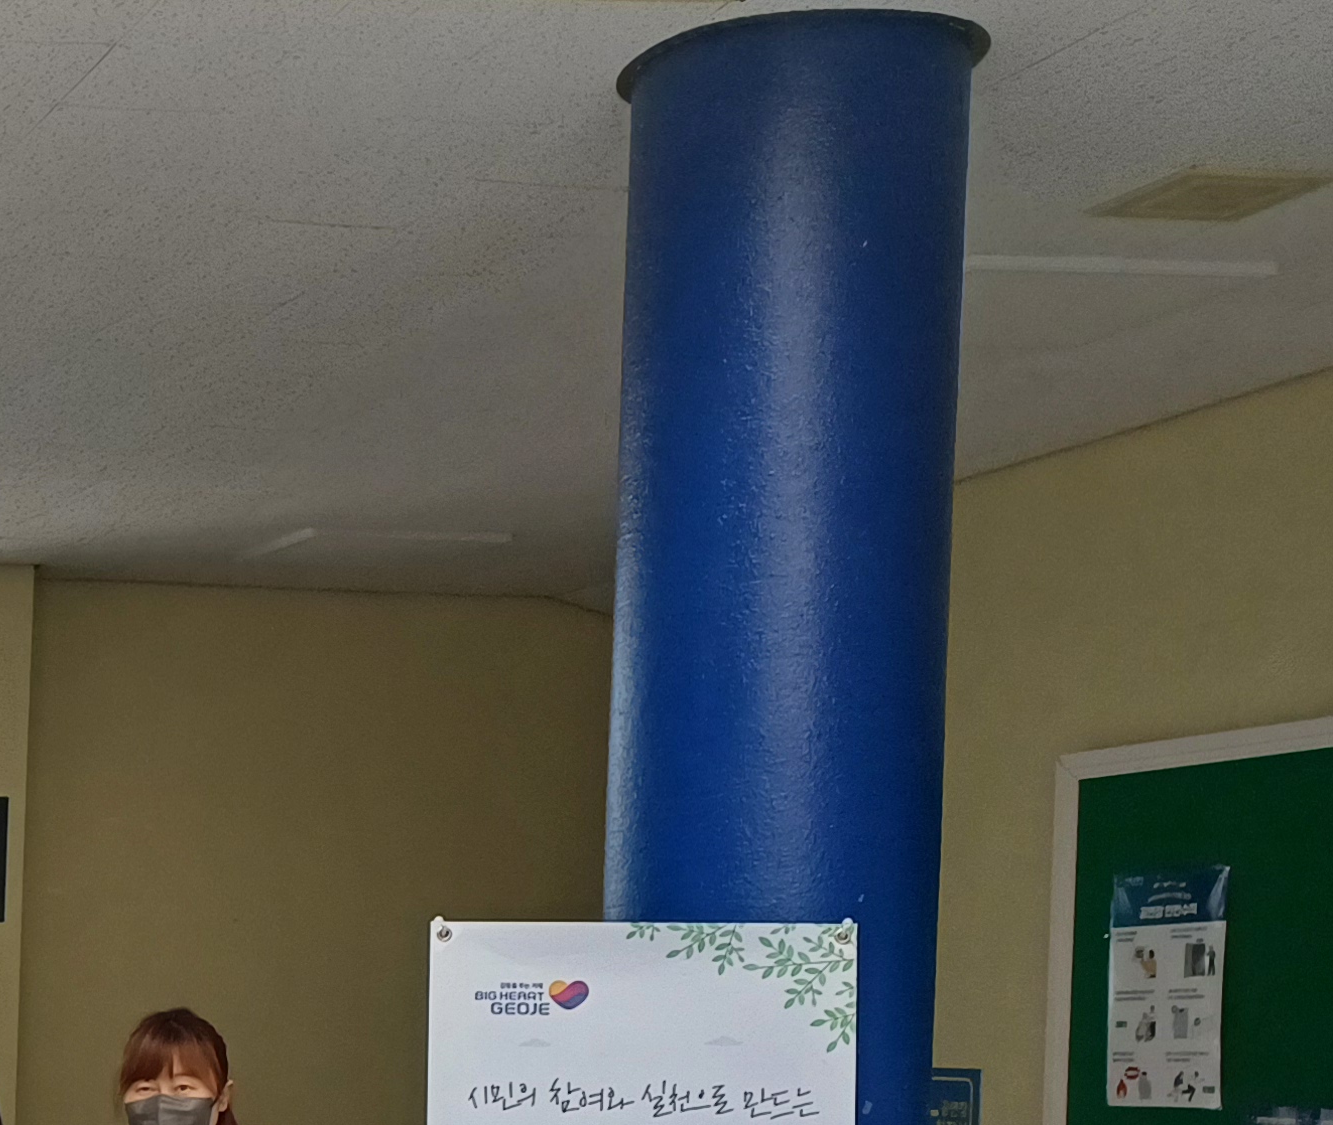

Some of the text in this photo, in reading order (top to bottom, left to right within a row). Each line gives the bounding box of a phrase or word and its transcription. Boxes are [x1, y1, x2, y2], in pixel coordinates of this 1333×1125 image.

[475, 990, 544, 1001] BIG HEART
[491, 1002, 550, 1015] GEOJE
[468, 1077, 820, 1120] 시민의 참여와 실천으로 만드는
